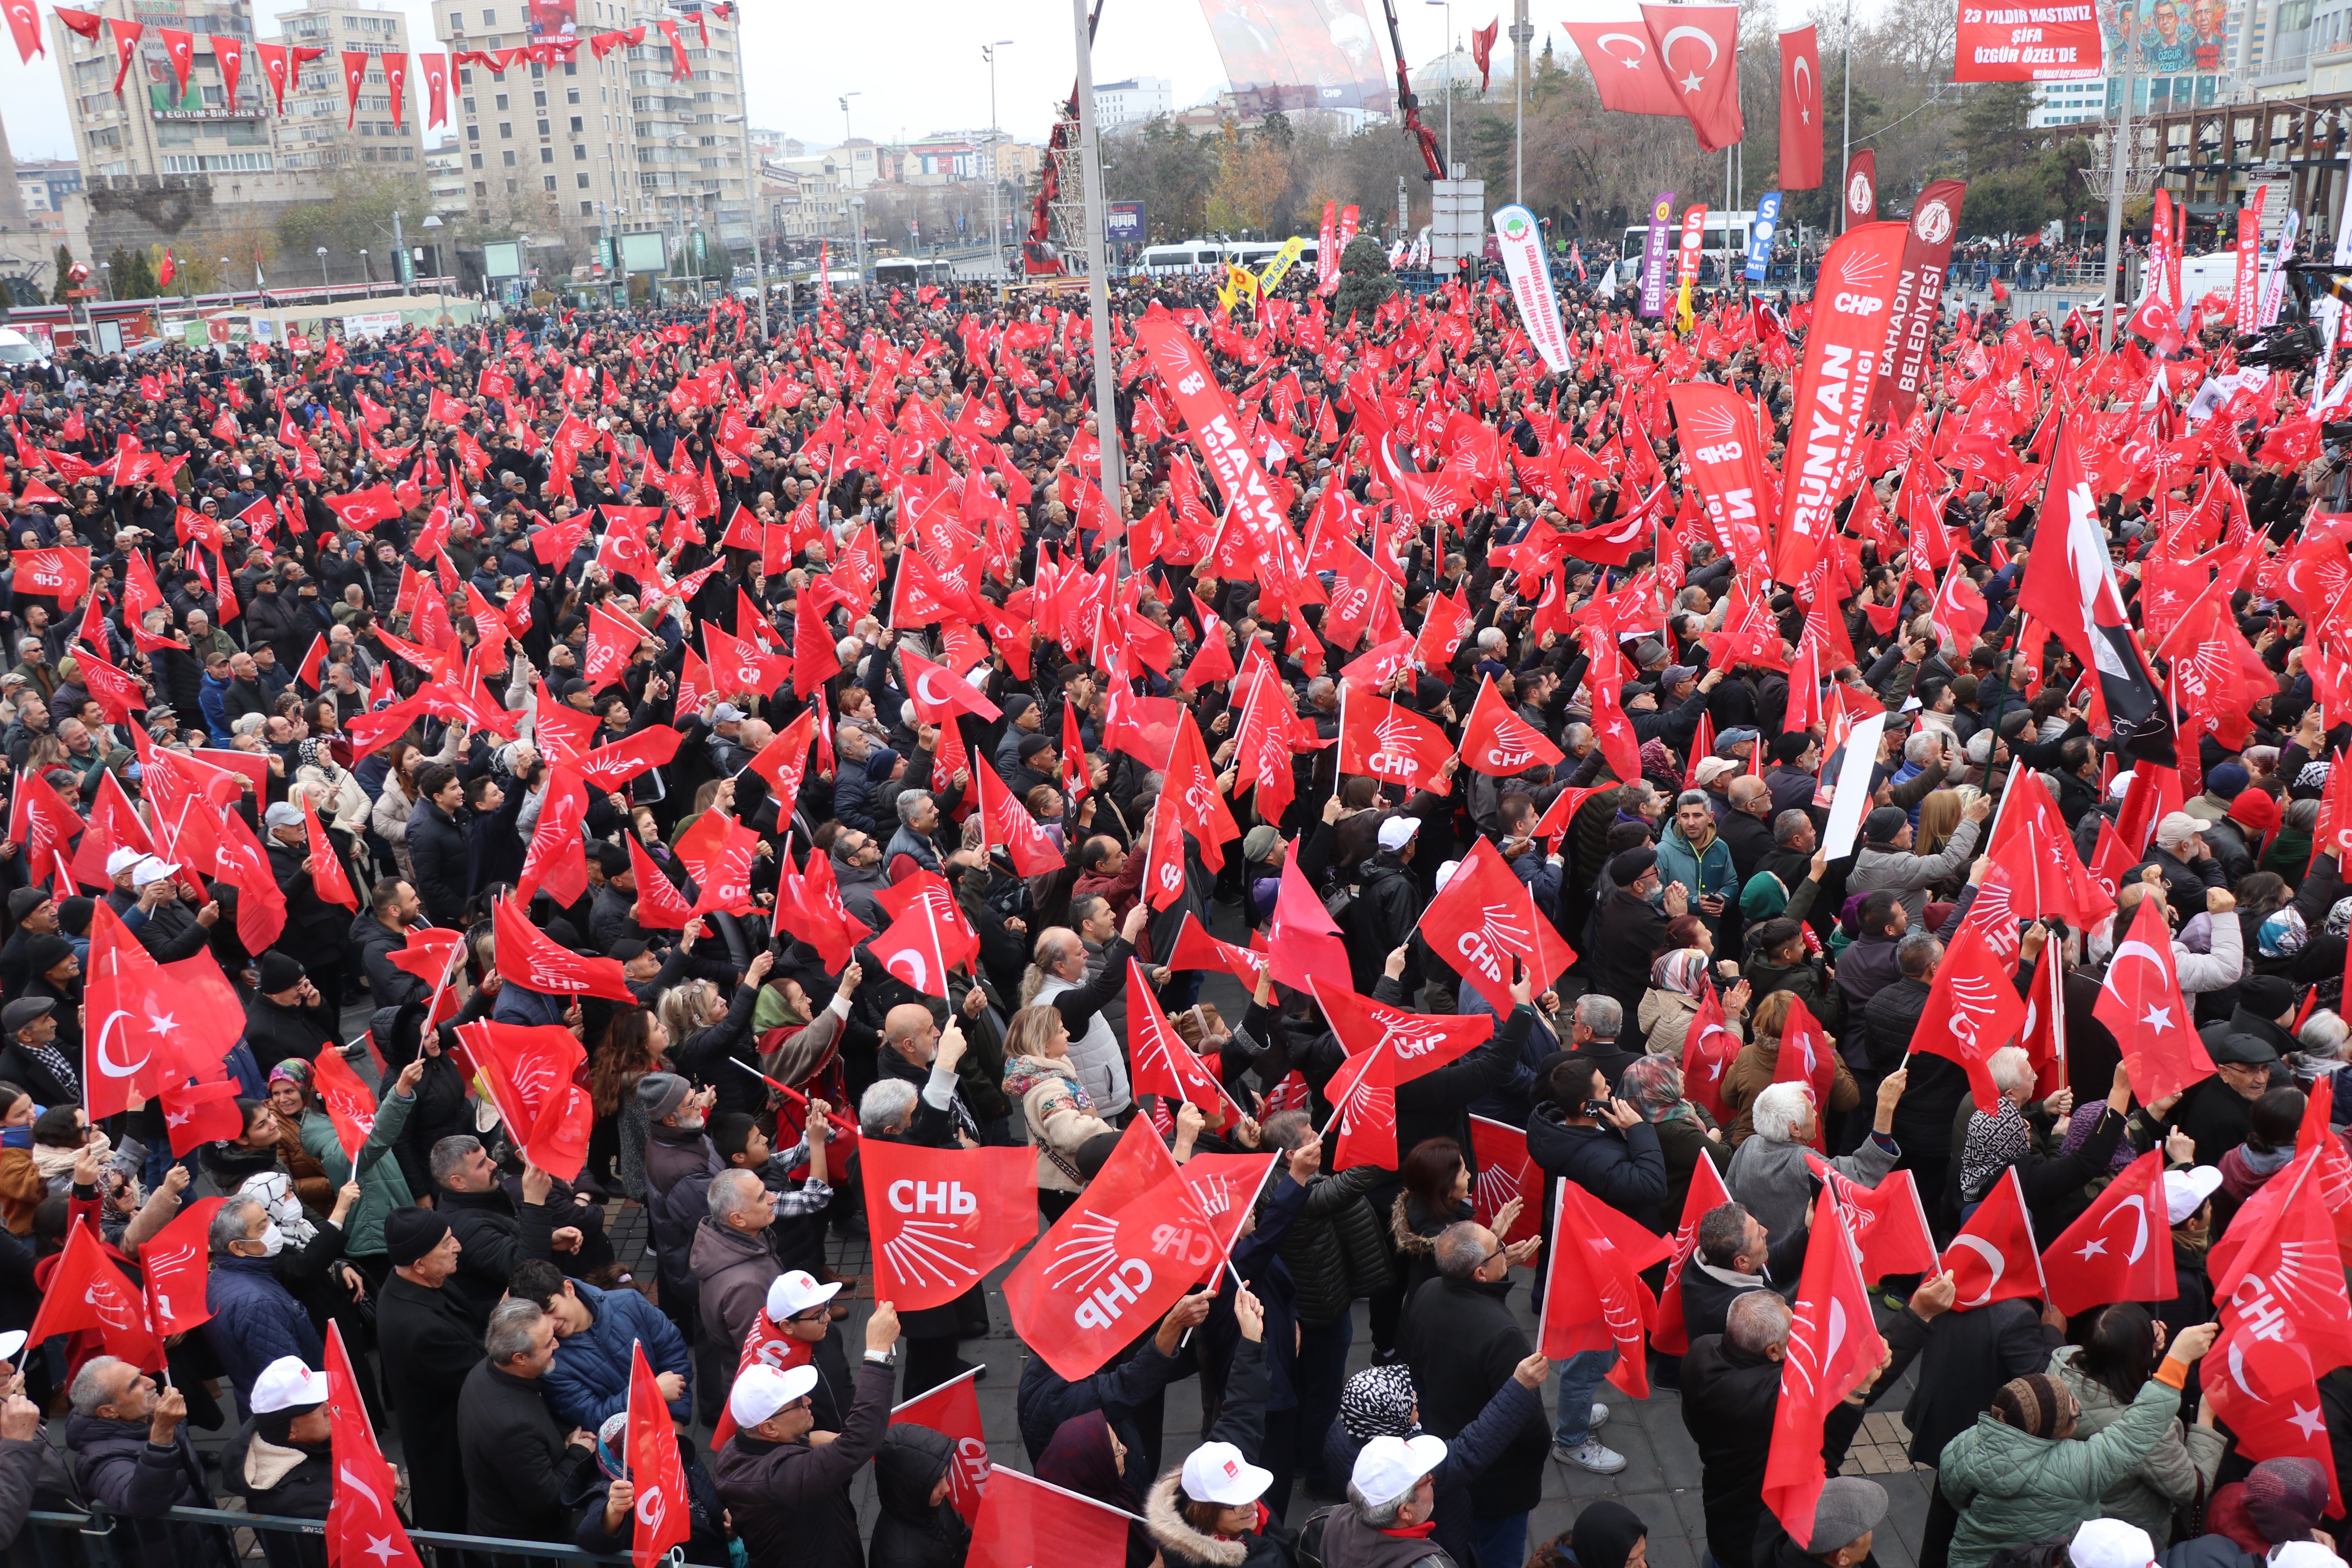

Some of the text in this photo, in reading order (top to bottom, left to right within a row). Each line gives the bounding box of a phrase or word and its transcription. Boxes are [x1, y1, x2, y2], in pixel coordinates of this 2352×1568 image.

[1964, 5, 2092, 24] 23 YILDIR HASTAYIZ
[2011, 27, 2042, 46] ŞİFA
[1974, 46, 2019, 64] ÖZGÜR
[2158, 47, 2182, 61] ÖZGÜR
[2033, 69, 2060, 79] MELİKGAZİ
[2059, 68, 2069, 80] İLÇE
[2158, 61, 2177, 73] ÖZEL
[1322, 89, 1342, 98] CHP
[1755, 200, 1776, 262] SOL
[1273, 254, 1289, 274] SEN
[1644, 226, 1666, 311] EĞİTİM SEN
[1835, 292, 1883, 316] CHP
[2267, 288, 2279, 325] ŞUBESİ
[1878, 270, 1916, 377] BAHADIN
[1898, 264, 1942, 392] BELEDİYESİ
[1303, 341, 1316, 350] CHP
[884, 356, 899, 365] CHP
[1325, 361, 1337, 376] CHP
[1959, 356, 1975, 367] CHP
[908, 366, 924, 375] CHP
[2182, 370, 2200, 386] CHP
[974, 417, 992, 428] CHP
[1426, 421, 1443, 433] CHP
[1831, 350, 1875, 490] BAŞKANLIĞI
[811, 450, 826, 467] CHP
[1082, 453, 1101, 462] CHP
[1428, 502, 1457, 519] CHP
[1397, 513, 1412, 539] CHP
[932, 524, 953, 549] CHP
[1149, 534, 1163, 555] CHP
[1677, 531, 1697, 551] CH
[681, 579, 700, 595] CHP
[586, 644, 616, 676] CHP
[737, 665, 761, 685] CHP
[2177, 657, 2208, 697] CHP
[1368, 751, 1420, 777] CHP
[1487, 748, 1535, 766] CHP
[1258, 753, 1276, 788] CHP
[778, 764, 800, 800] CHP
[1160, 861, 1183, 892] CHP
[1457, 931, 1502, 983] CHP
[529, 974, 591, 990] CHP
[2231, 1272, 2295, 1343] CHP
